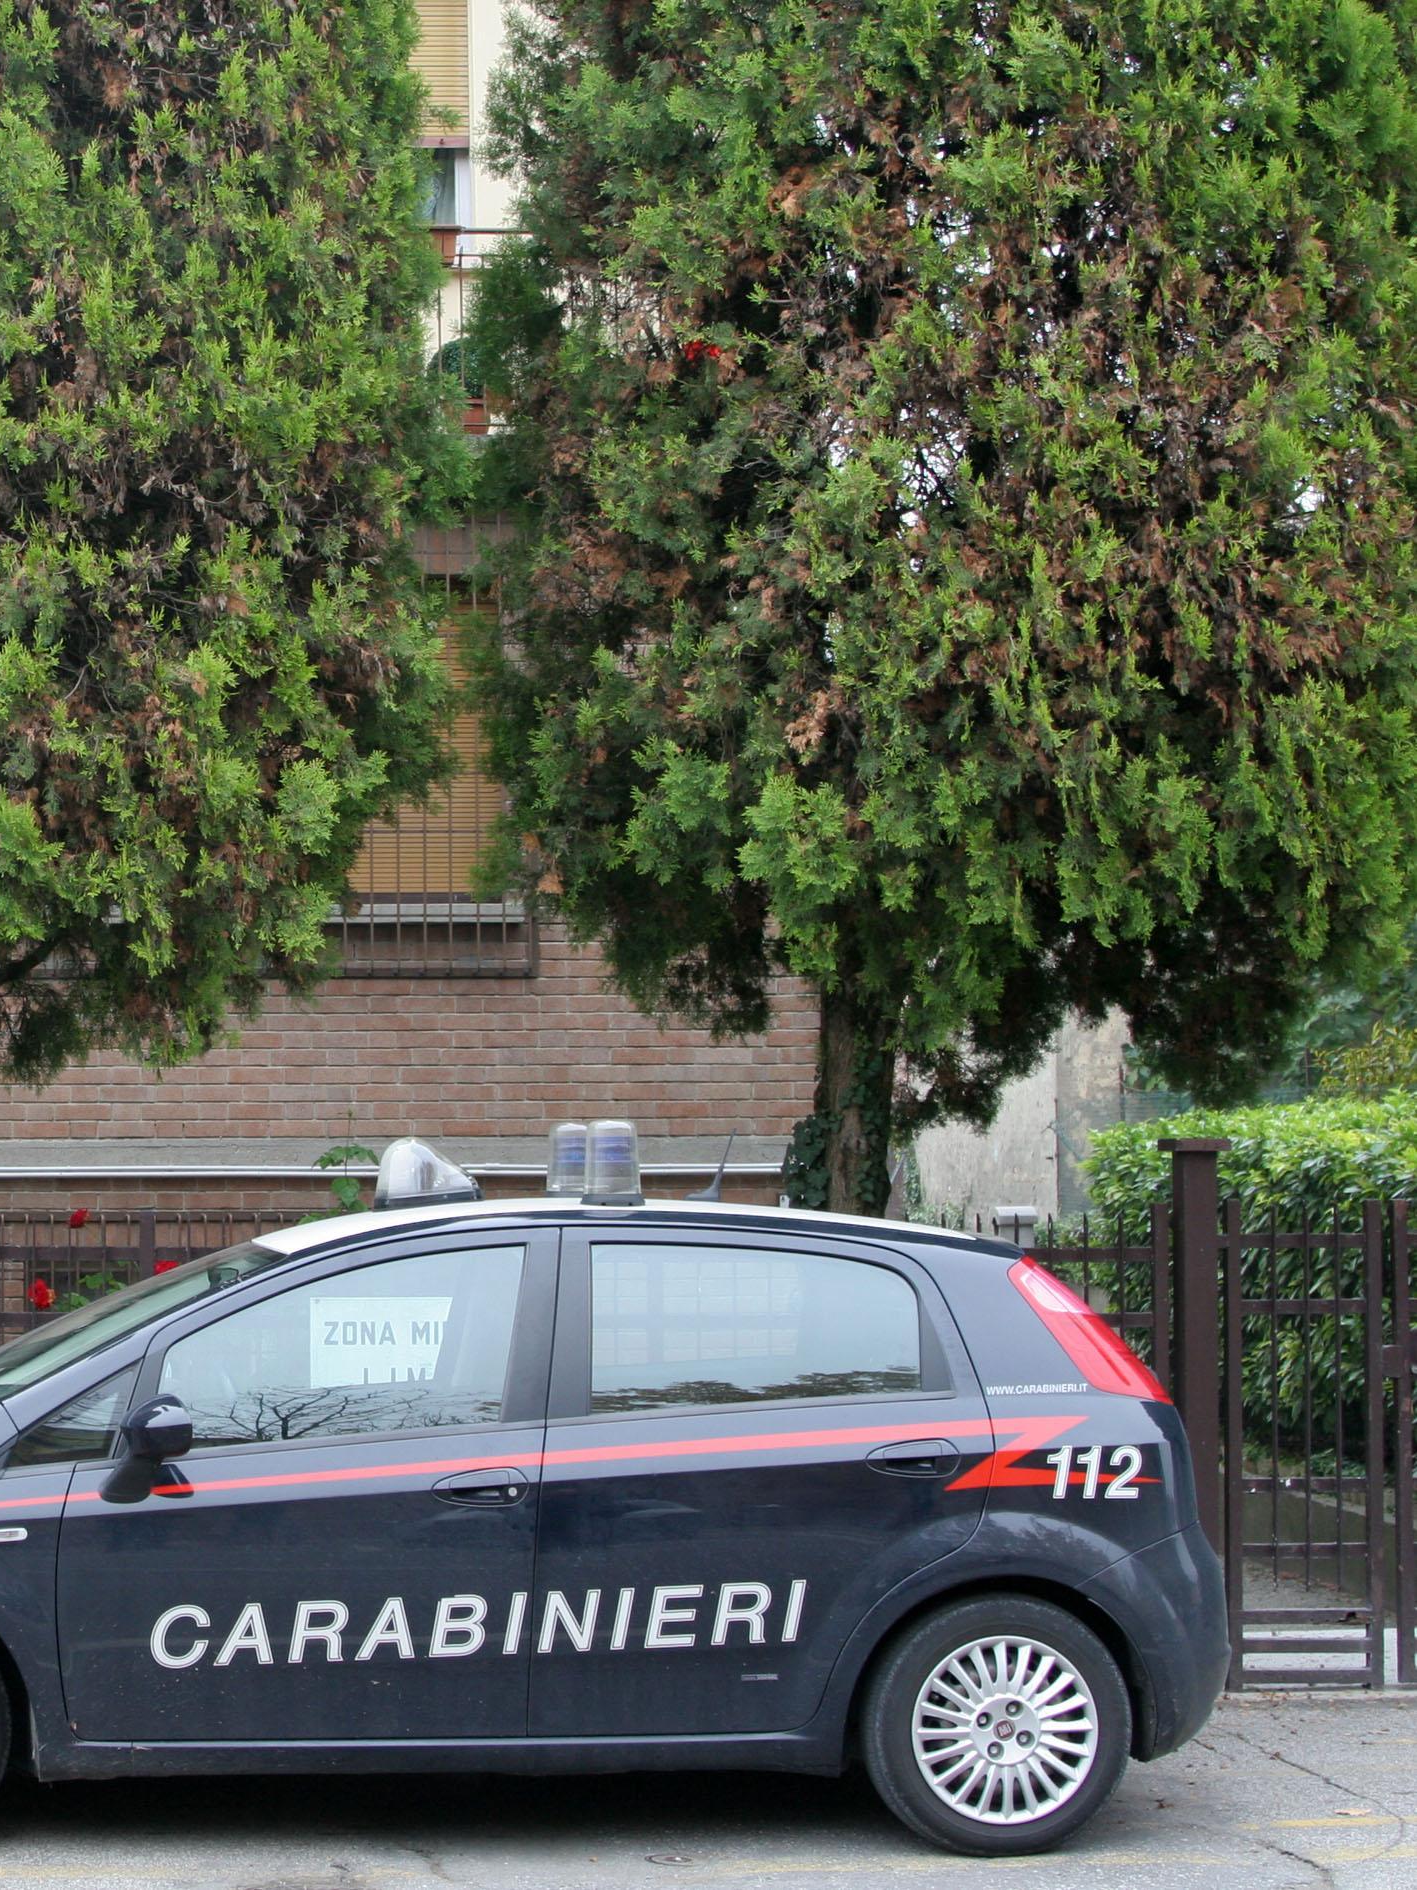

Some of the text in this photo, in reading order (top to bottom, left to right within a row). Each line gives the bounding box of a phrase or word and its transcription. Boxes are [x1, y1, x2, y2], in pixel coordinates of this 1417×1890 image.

[324, 1321, 447, 1346] ZONA MI
[986, 1383, 1088, 1396] WWW.CARABINIERI.IT
[1046, 1445, 1143, 1499] 112
[149, 1579, 807, 1669] CARABINIERI
